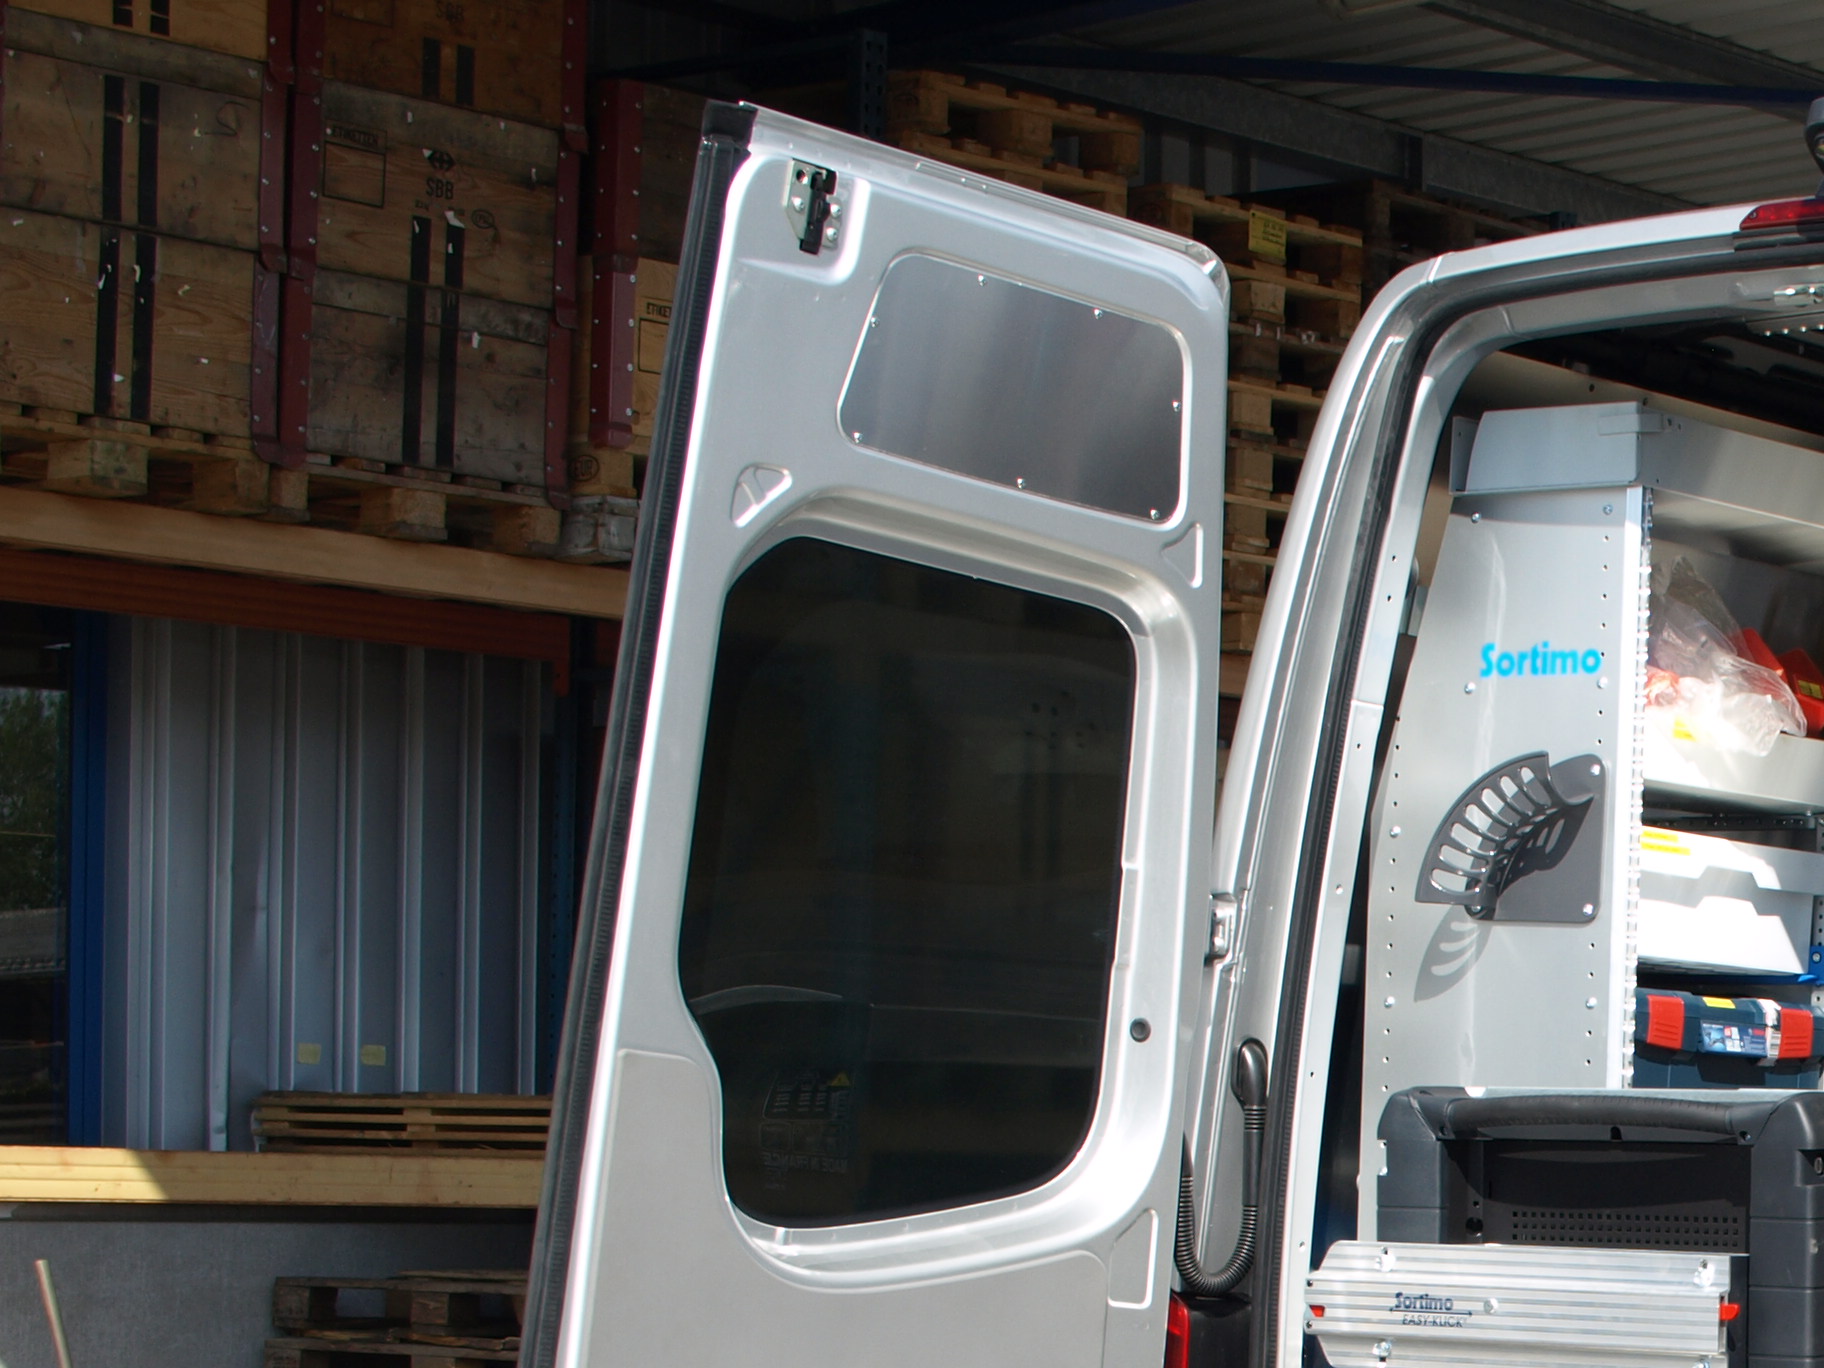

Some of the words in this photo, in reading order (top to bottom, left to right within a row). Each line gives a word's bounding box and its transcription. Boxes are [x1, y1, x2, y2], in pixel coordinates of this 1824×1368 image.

[426, 177, 454, 199] SBB
[1480, 641, 1602, 678] Sortimo
[1394, 1291, 1454, 1311] Sortimo
